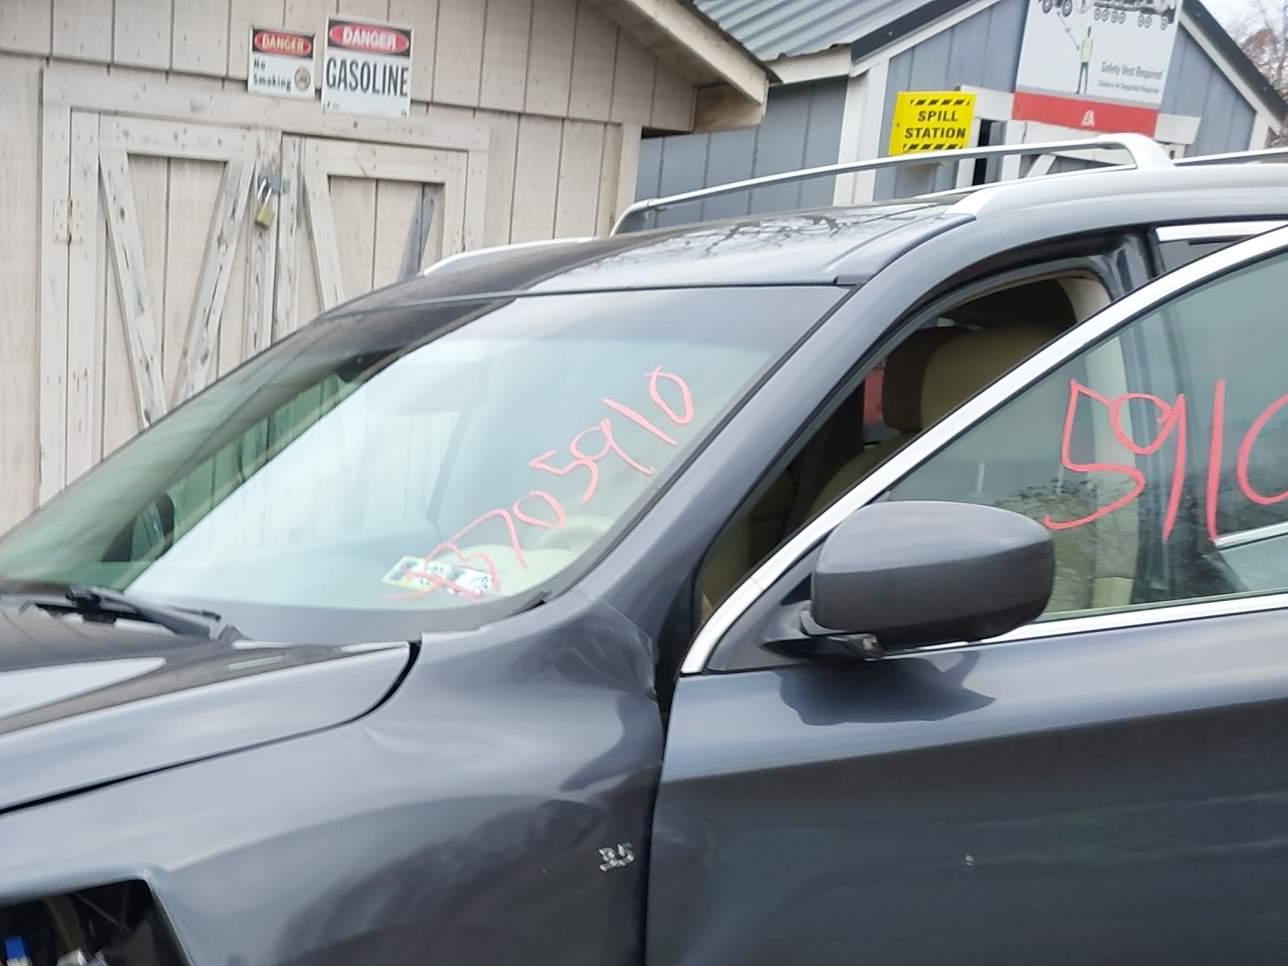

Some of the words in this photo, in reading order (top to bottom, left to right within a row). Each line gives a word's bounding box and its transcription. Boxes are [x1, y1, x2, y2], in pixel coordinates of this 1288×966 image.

[262, 33, 304, 54] DANGER
[342, 26, 397, 51] DANGER
[253, 74, 292, 92] Smoking
[326, 57, 409, 97] GASOLINE
[917, 110, 959, 122] SPILL
[904, 127, 966, 139] STATION
